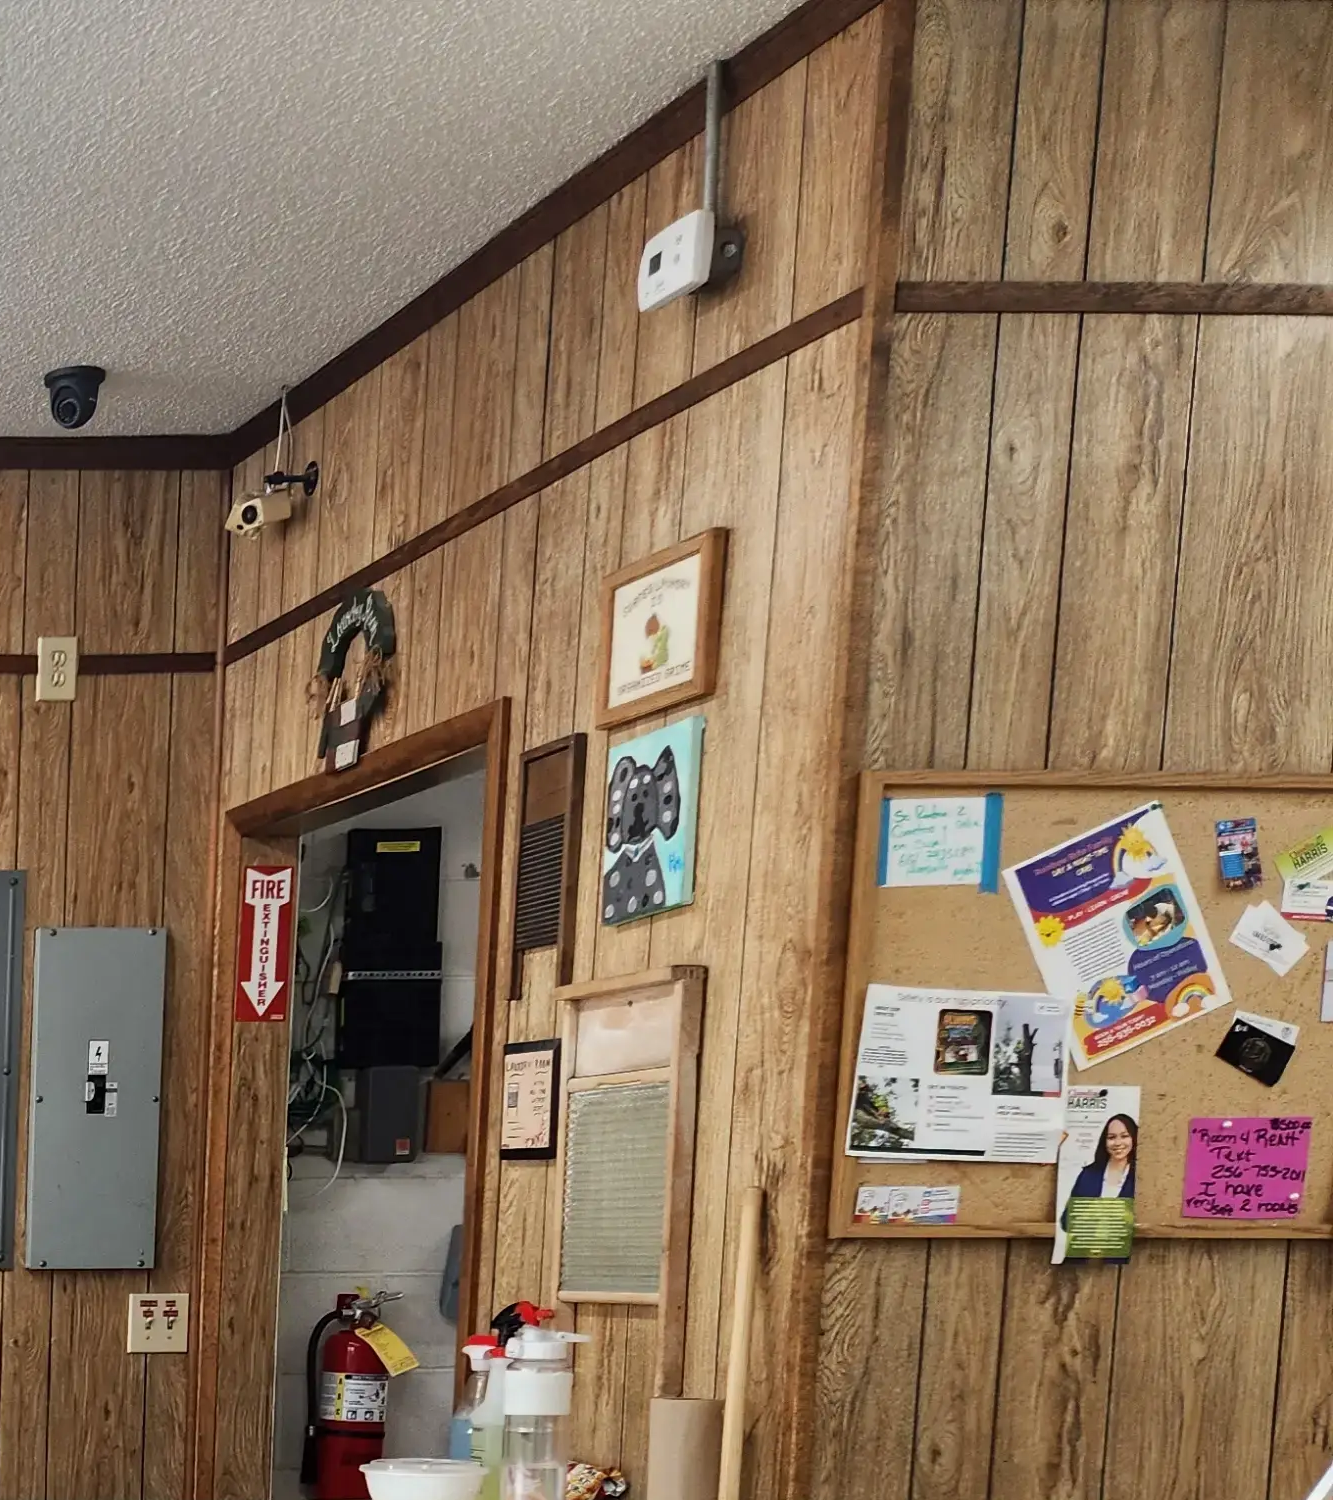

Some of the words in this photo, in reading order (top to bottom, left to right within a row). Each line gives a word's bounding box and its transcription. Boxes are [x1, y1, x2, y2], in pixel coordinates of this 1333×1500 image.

[1292, 842, 1329, 870] HARRIS
[251, 879, 286, 900] FIRE
[257, 903, 272, 1007] EXTINGUISHER
[1240, 1130, 1250, 1145] 4
[1224, 1181, 1264, 1198] have
[1239, 1199, 1252, 1212] 2
